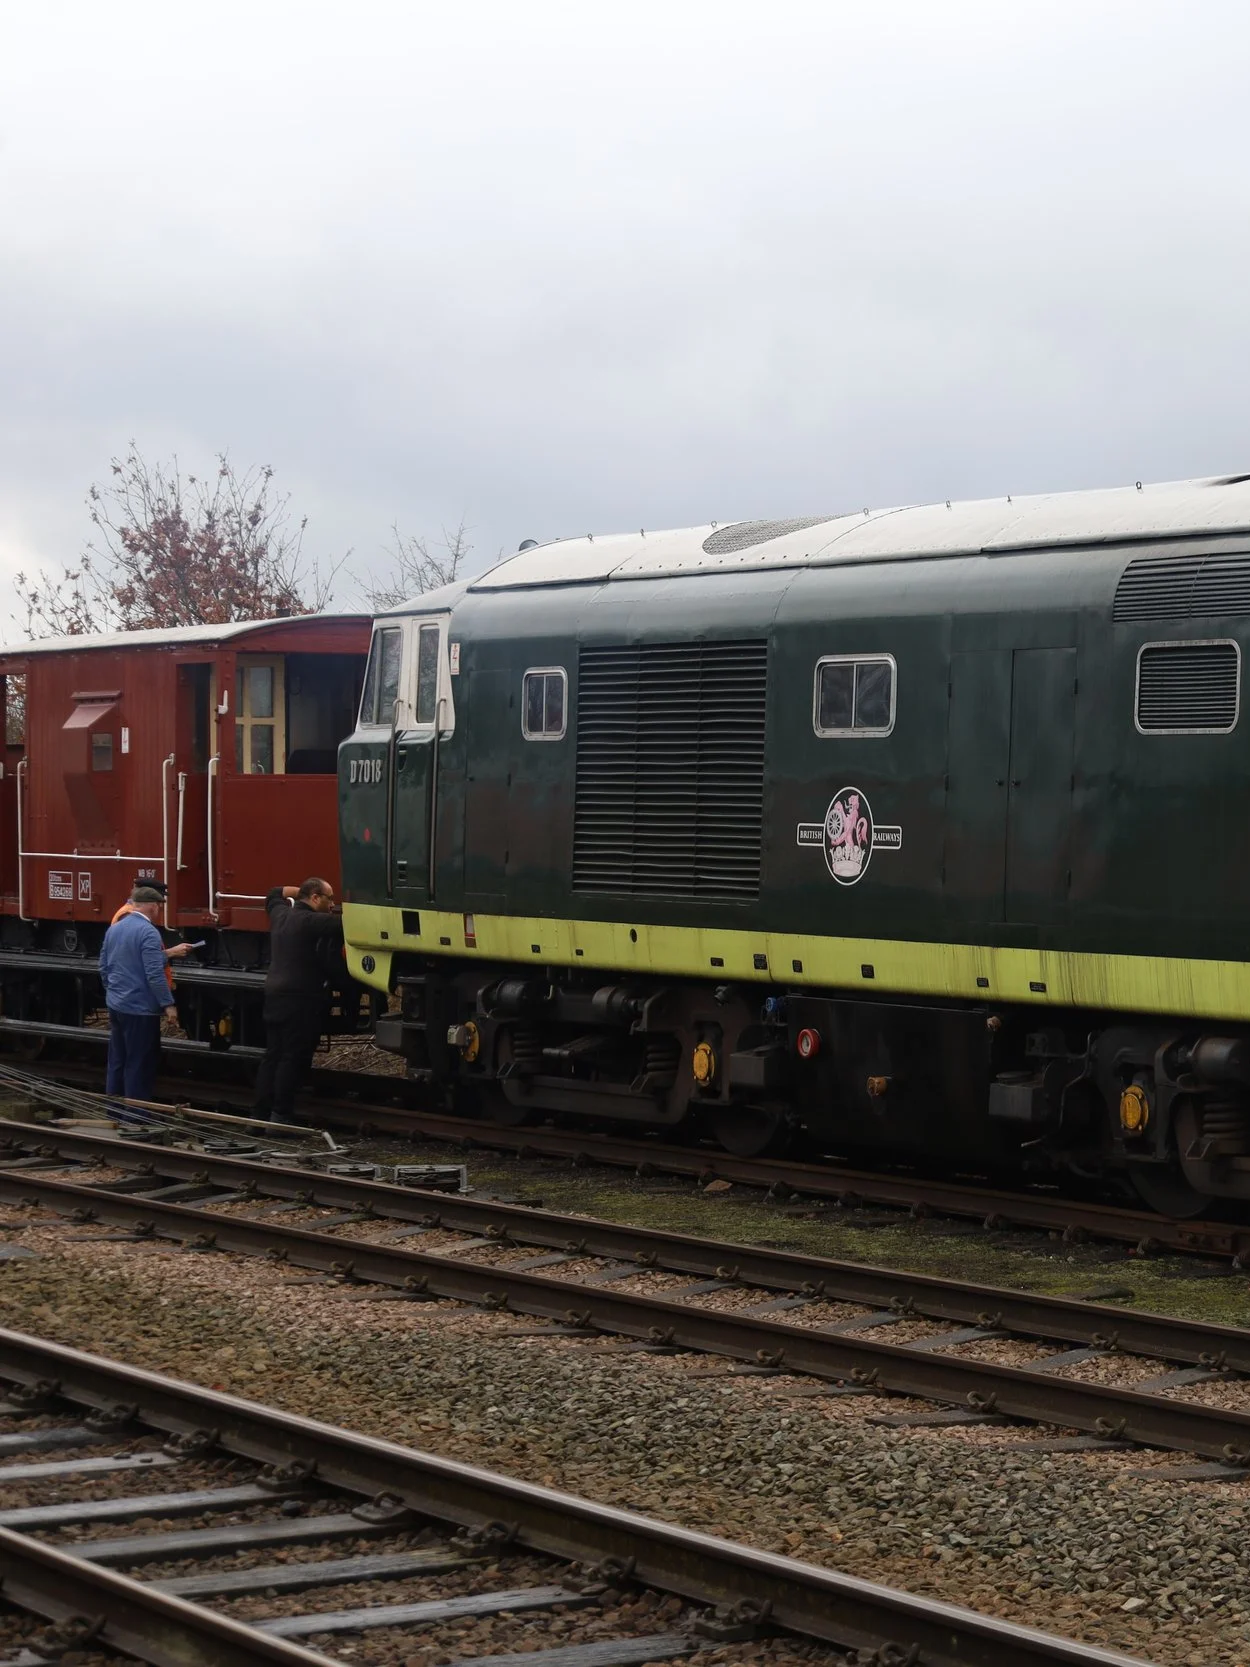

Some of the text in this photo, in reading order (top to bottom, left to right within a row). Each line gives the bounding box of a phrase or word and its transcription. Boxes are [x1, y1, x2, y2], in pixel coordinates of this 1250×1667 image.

[350, 759, 381, 783] D7018
[800, 830, 900, 842] BRITISH RAILWAYS
[80, 880, 90, 893] XP
